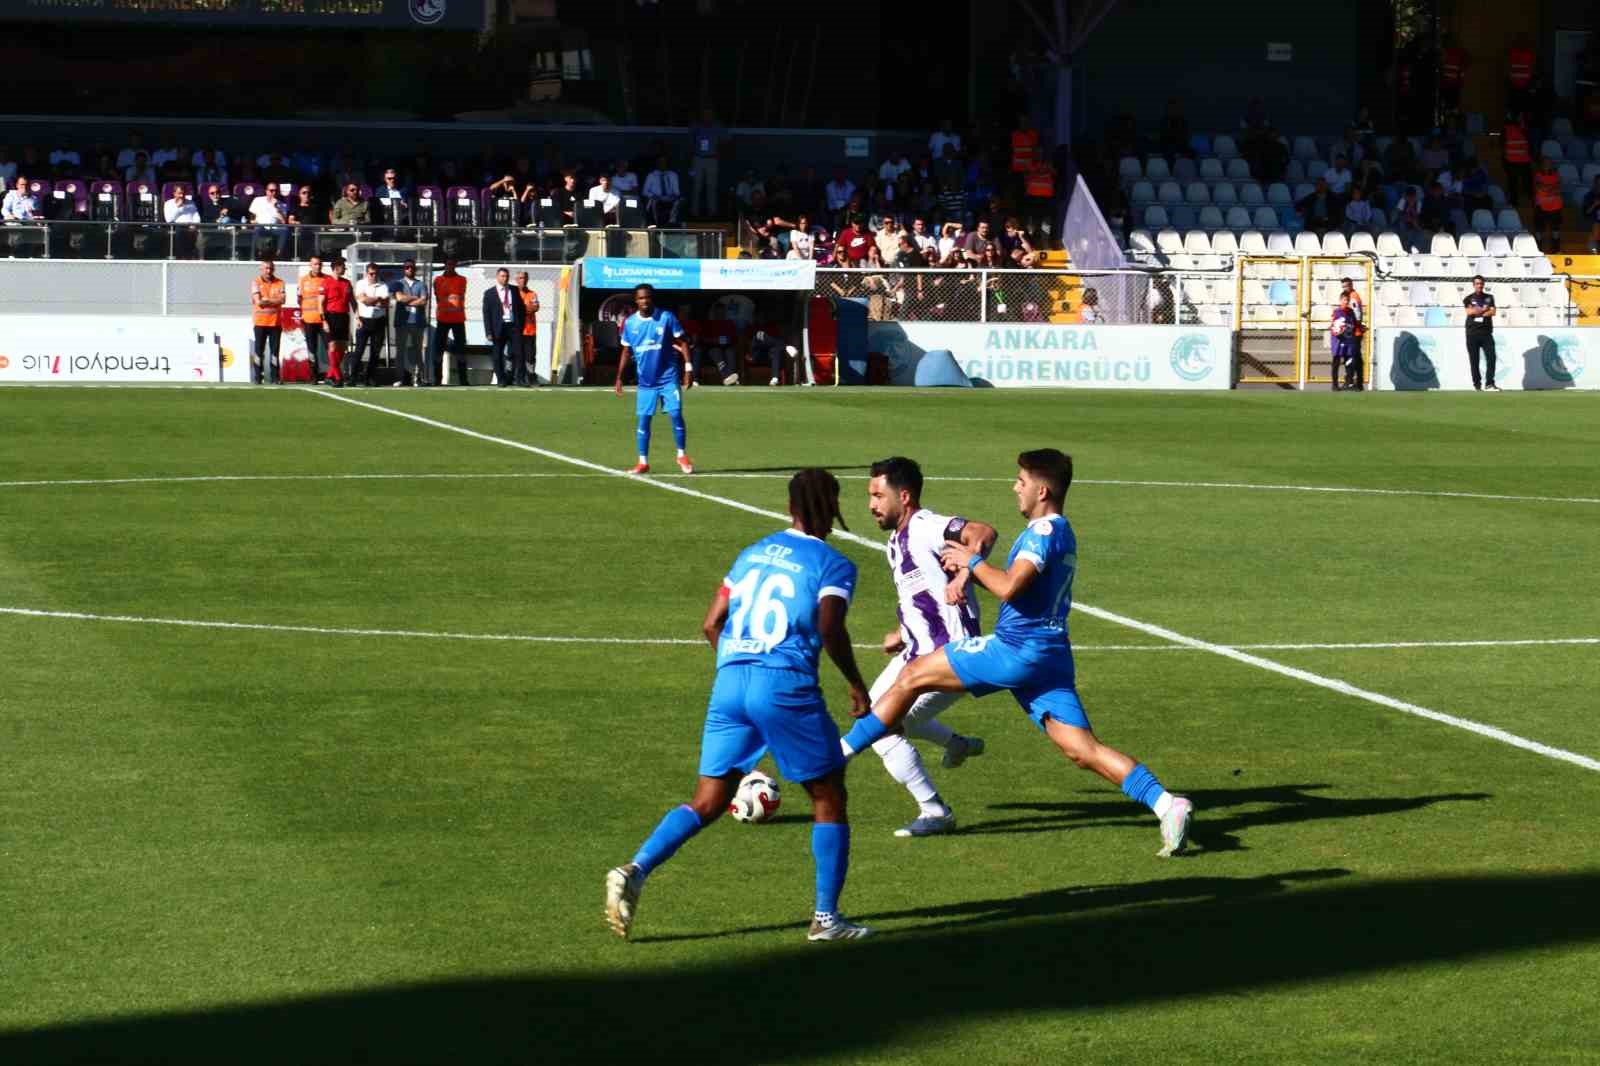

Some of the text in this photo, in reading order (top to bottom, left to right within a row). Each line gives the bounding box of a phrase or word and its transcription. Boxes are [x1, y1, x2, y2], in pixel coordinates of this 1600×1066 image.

[984, 329, 1097, 350] ANKARA
[70, 352, 171, 374] trendyol
[729, 568, 795, 647] 16
